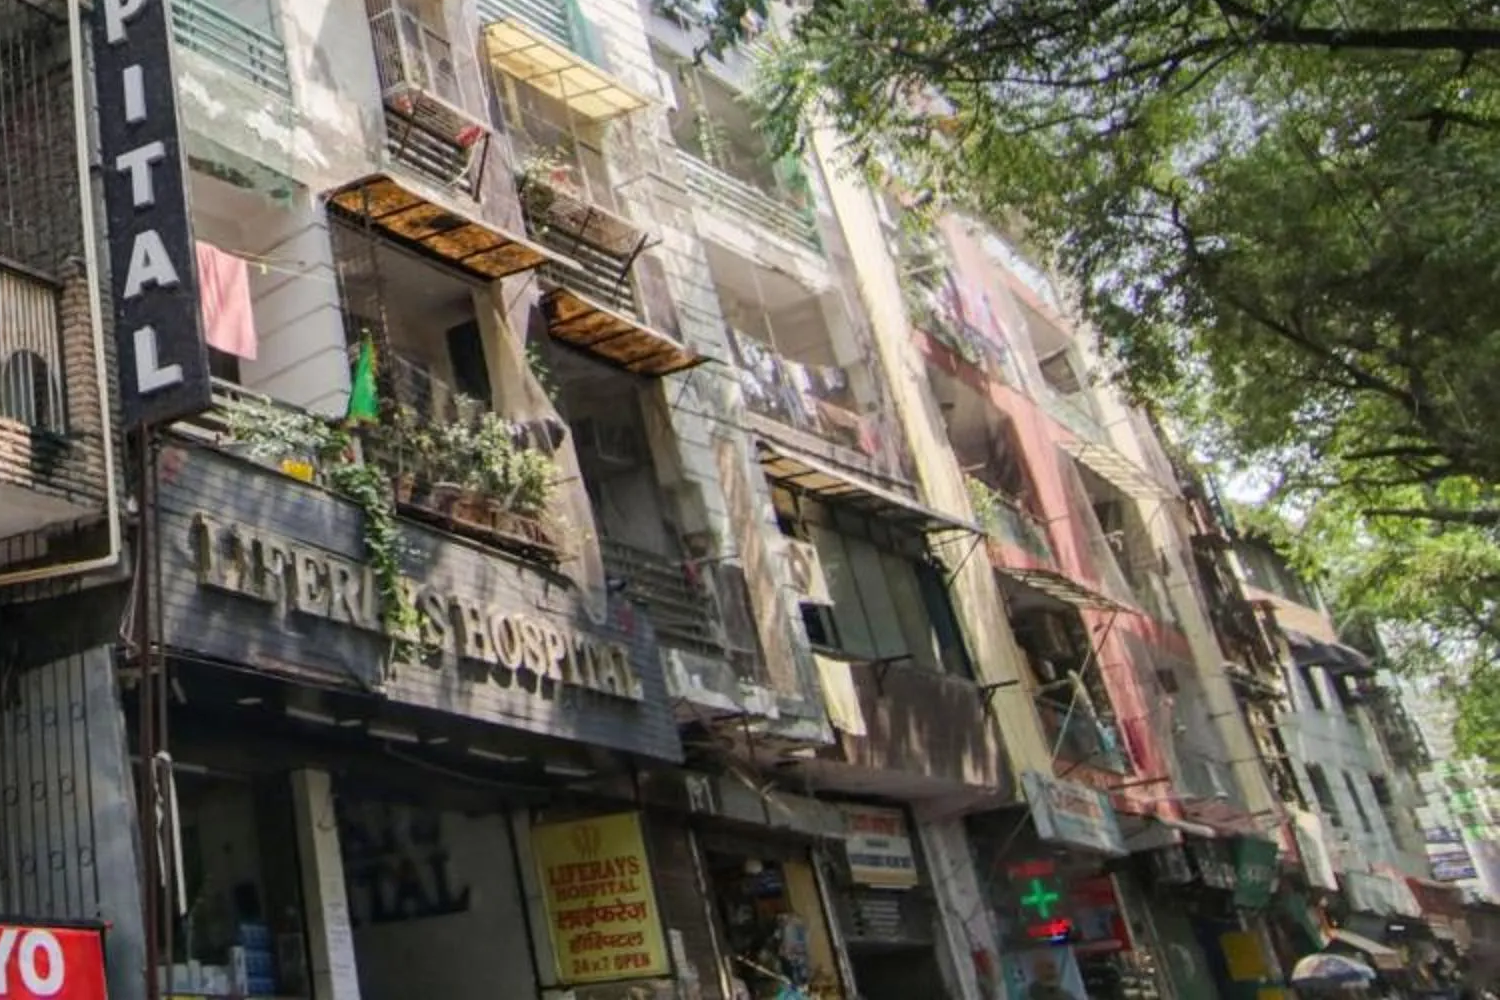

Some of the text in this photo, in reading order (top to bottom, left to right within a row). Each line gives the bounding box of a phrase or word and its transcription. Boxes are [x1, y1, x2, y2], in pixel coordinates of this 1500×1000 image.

[548, 855, 641, 885] LIFERAYS
[555, 878, 640, 902] HOSPITAL
[614, 952, 651, 970] OPEN
